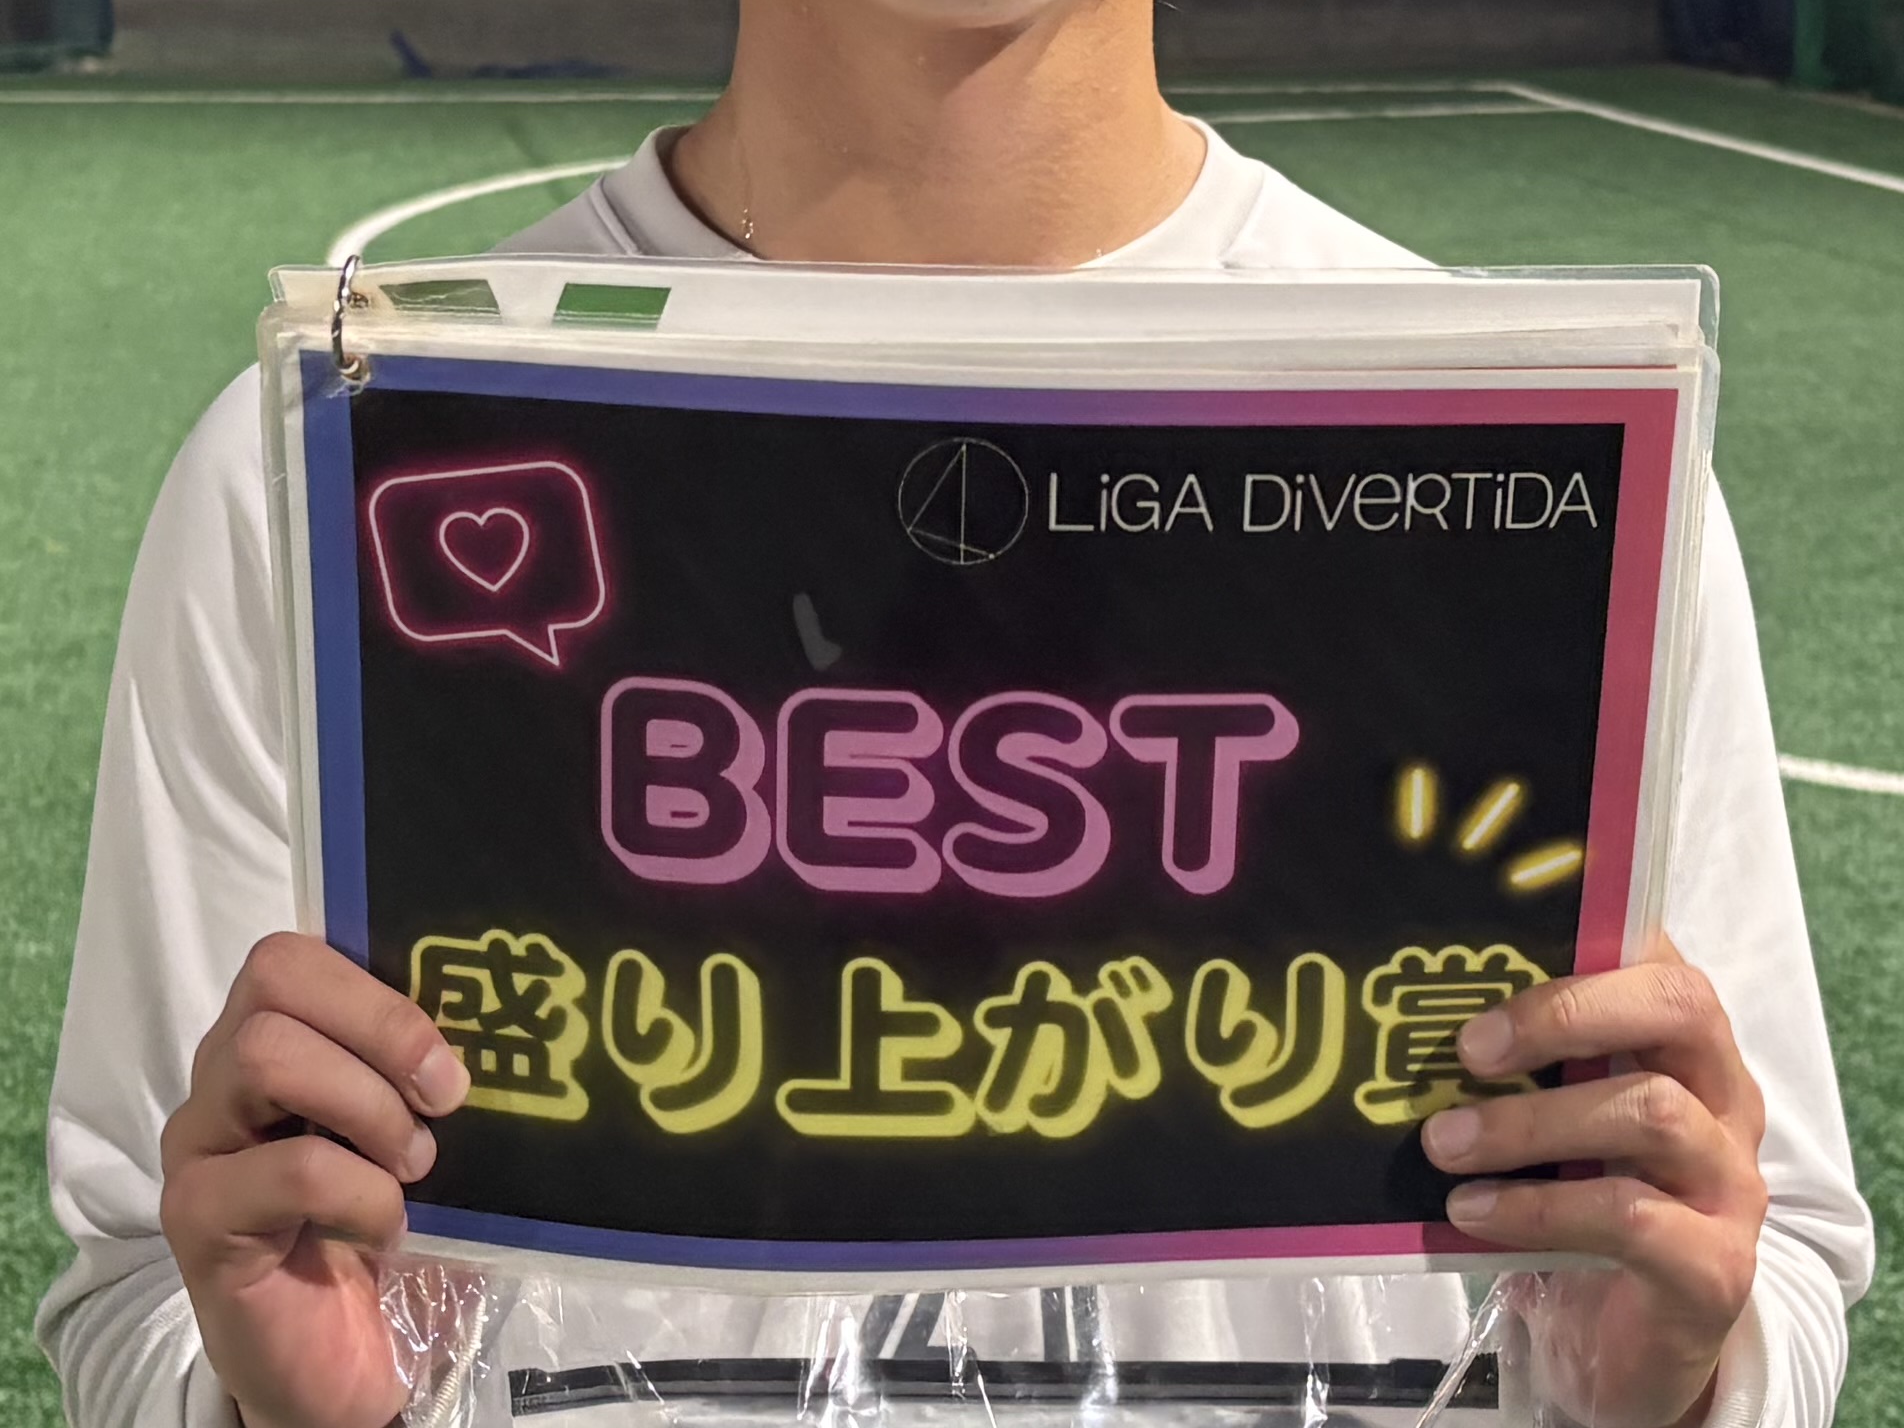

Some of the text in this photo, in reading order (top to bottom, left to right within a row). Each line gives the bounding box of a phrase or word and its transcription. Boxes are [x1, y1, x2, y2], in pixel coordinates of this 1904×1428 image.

[600, 675, 1299, 898] BEST
[408, 928, 1554, 1139] 盛り上がり賞
